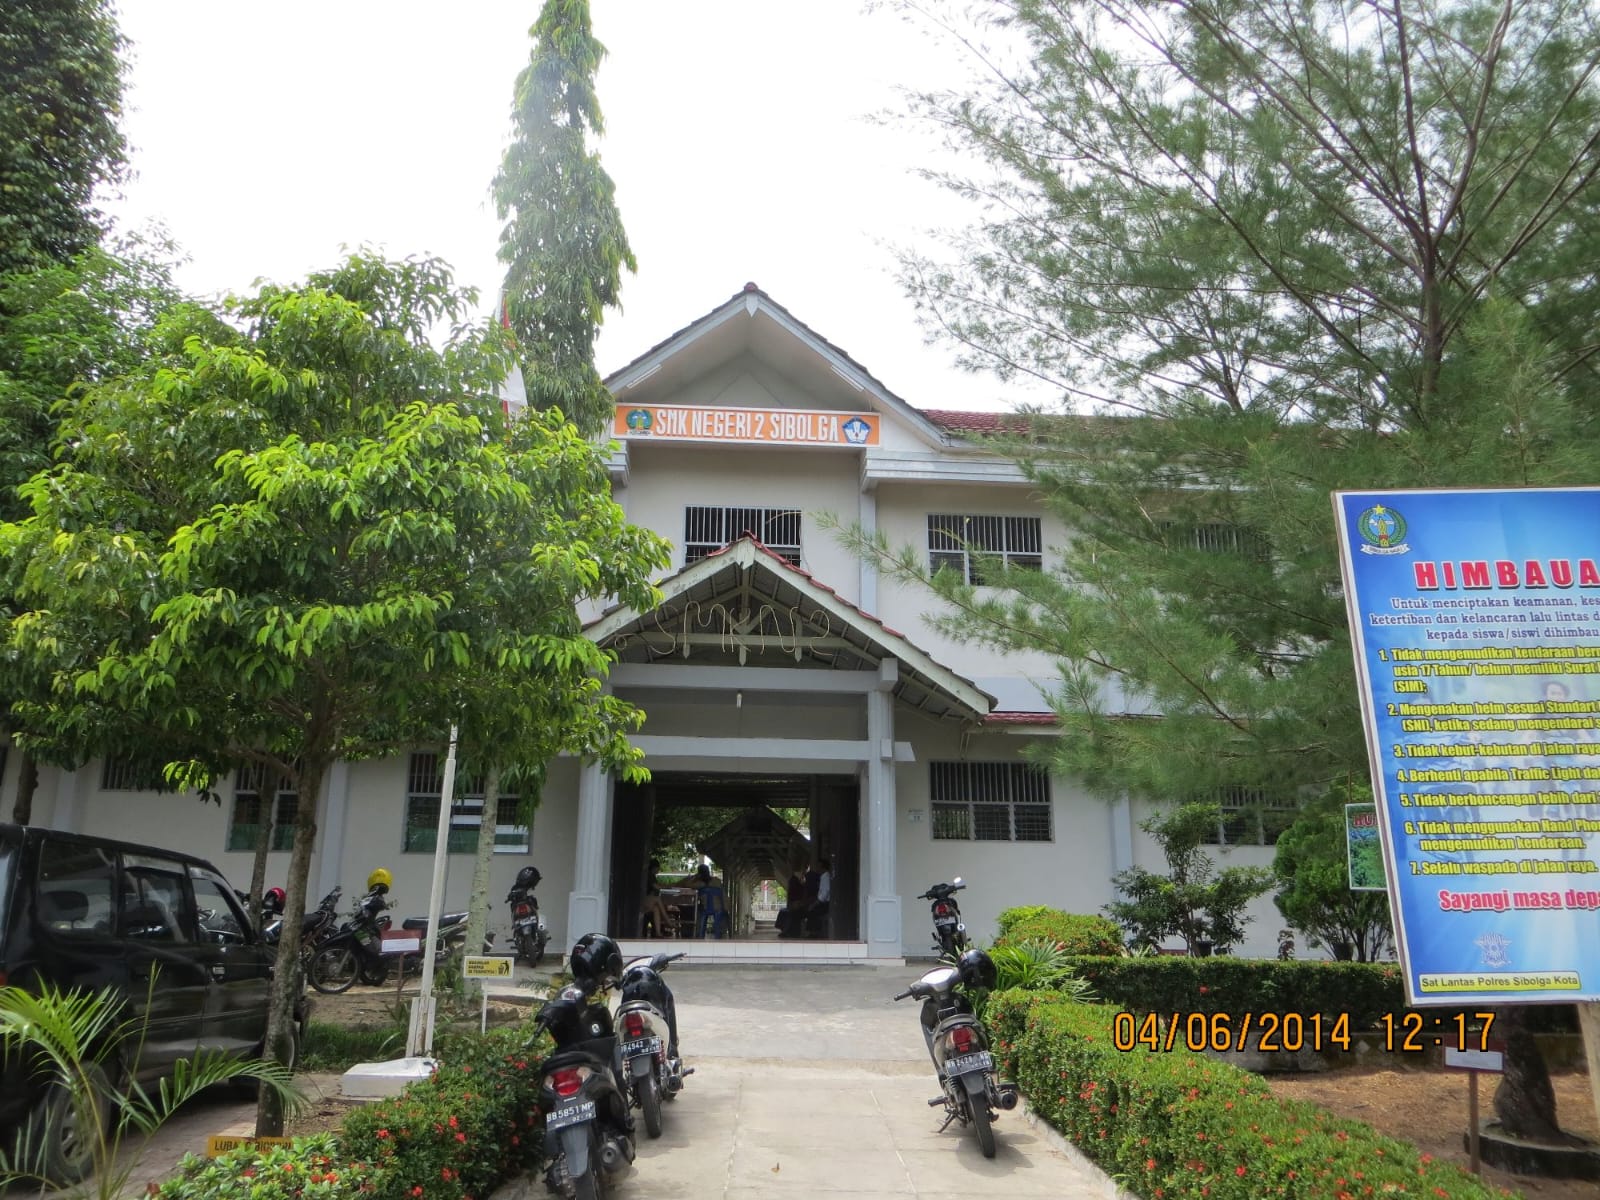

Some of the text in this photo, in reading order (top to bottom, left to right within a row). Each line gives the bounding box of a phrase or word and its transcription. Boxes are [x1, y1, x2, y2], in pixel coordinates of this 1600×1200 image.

[656, 409, 839, 441] SMK NEGERI 2 SIBOLGA
[1391, 598, 1429, 609] Untuk
[1432, 596, 1509, 610] menciptakan
[1513, 596, 1577, 607] keamanan,
[1370, 614, 1432, 625] ketertiban
[1436, 613, 1457, 624] dan
[1461, 612, 1526, 624] kelancaran
[1530, 611, 1552, 622] lalu
[1555, 611, 1590, 622] lintas
[1426, 626, 1600, 642] kepada siswa/siswi dihimbau
[1390, 648, 1423, 661] Tidak
[1424, 647, 1513, 661] mengemudikan
[1514, 646, 1575, 659] kendaraan
[1393, 664, 1419, 677] usia
[1420, 664, 1432, 676] 17
[1474, 663, 1512, 676] belum
[1512, 662, 1564, 675] memiliki
[1564, 661, 1595, 674] Surat
[1387, 700, 1596, 717] 2. Mengenakan helm sesuai Standart
[1433, 718, 1471, 731] ketika
[1472, 718, 1516, 731] sedang
[1516, 716, 1594, 730] mengendarai
[1393, 744, 1406, 758] 3.
[1406, 744, 1440, 757] Tidak
[1440, 743, 1528, 757] kebut-kebutan
[1528, 742, 1541, 755] di
[1542, 742, 1574, 756] jalan
[1397, 769, 1408, 782] 4.
[1409, 768, 1462, 782] Berhenti
[1463, 768, 1510, 782] apabila
[1510, 767, 1551, 781] Traffic
[1551, 767, 1582, 781] Light
[1400, 791, 1596, 807] 5. Tidak berboncengan lebih dari
[1404, 821, 1416, 834] 6.
[1417, 821, 1452, 834] Tidak
[1453, 820, 1541, 835] menggunakan
[1541, 819, 1574, 832] Hand
[1419, 836, 1587, 851] mengemudikan kendaraan.
[1409, 859, 1599, 875] 7. Selalu waspada di jalan raya.
[1438, 889, 1511, 911] Sayangi
[1512, 891, 1563, 910] masa
[1421, 975, 1578, 987] Sat Lantas Polres Sibolga Kota
[546, 1101, 593, 1122] BB 5851 MP
